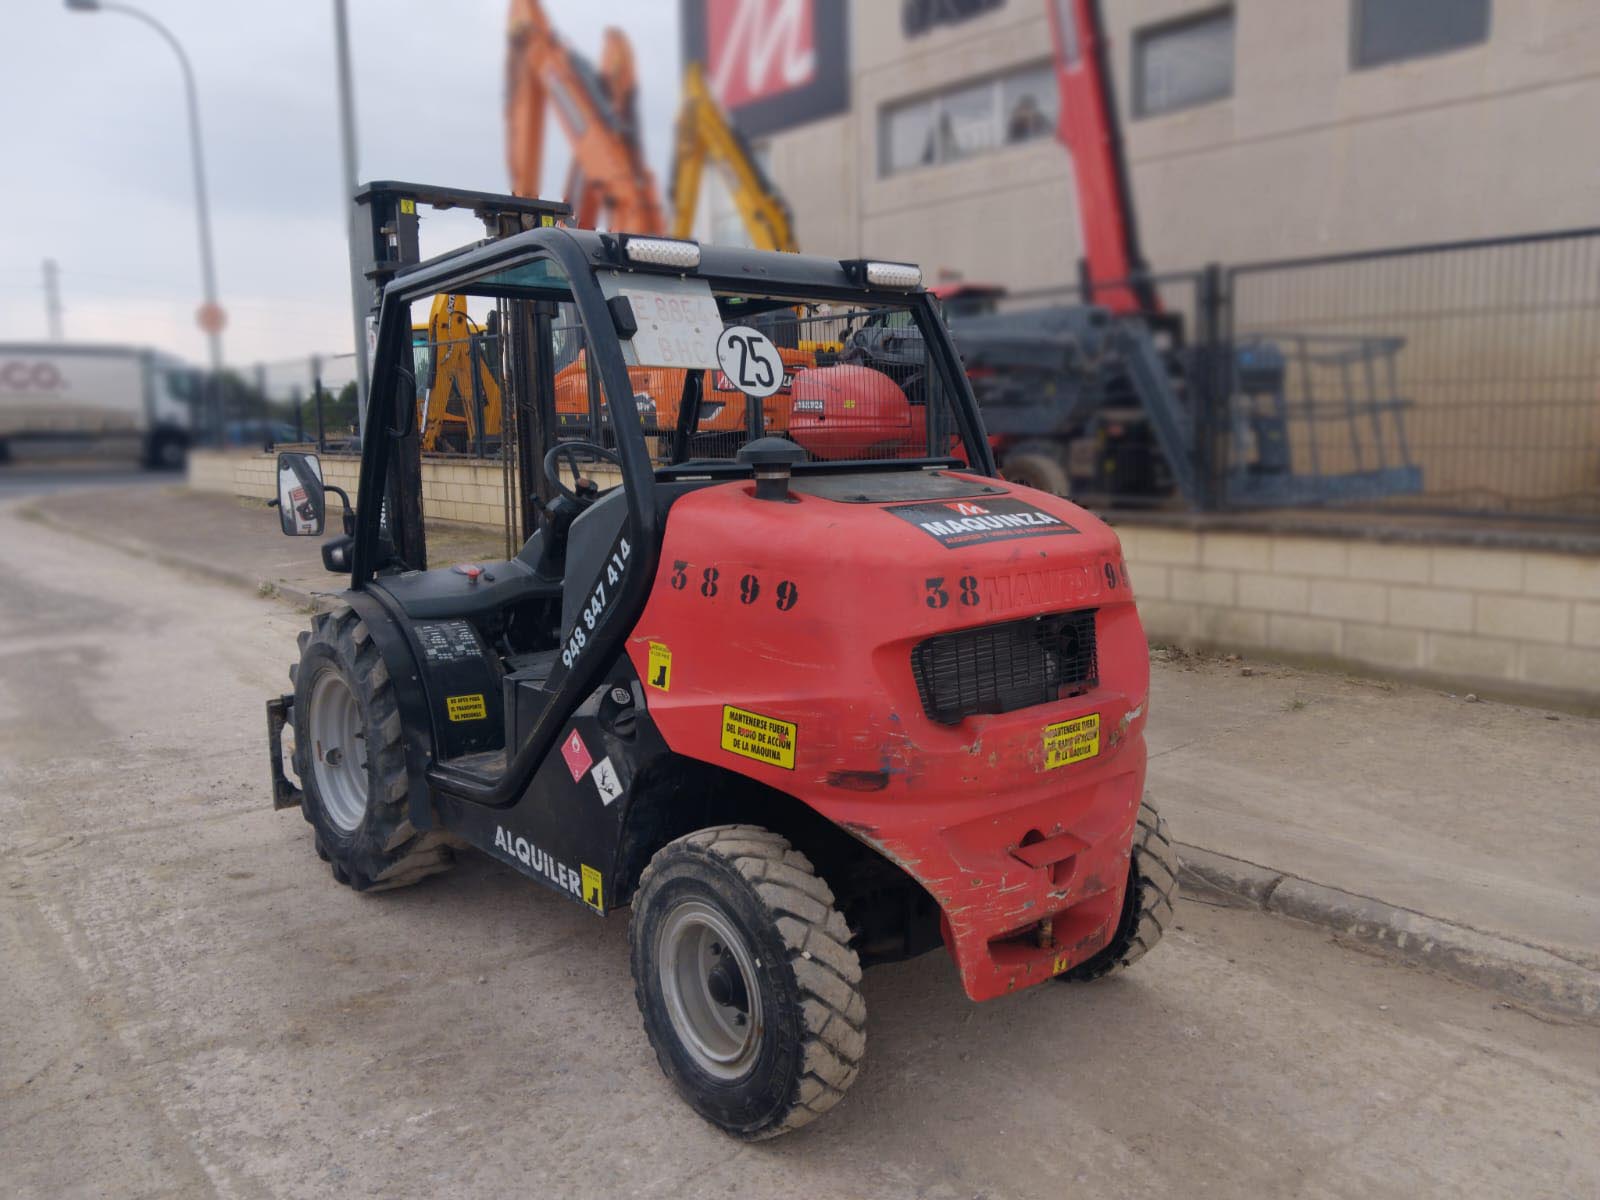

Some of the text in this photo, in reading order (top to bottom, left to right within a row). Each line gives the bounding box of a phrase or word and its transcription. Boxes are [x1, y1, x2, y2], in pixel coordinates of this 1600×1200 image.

[727, 335, 774, 387] 25
[920, 512, 1061, 536] MAQUINZA
[562, 538, 631, 669] 948 847 414
[727, 723, 736, 734] DEL
[758, 733, 766, 743] DE
[730, 711, 789, 736] MANTENERSE FUERA
[734, 739, 741, 749] DE
[742, 741, 749, 751] LA
[494, 825, 582, 898] ALQUILER
